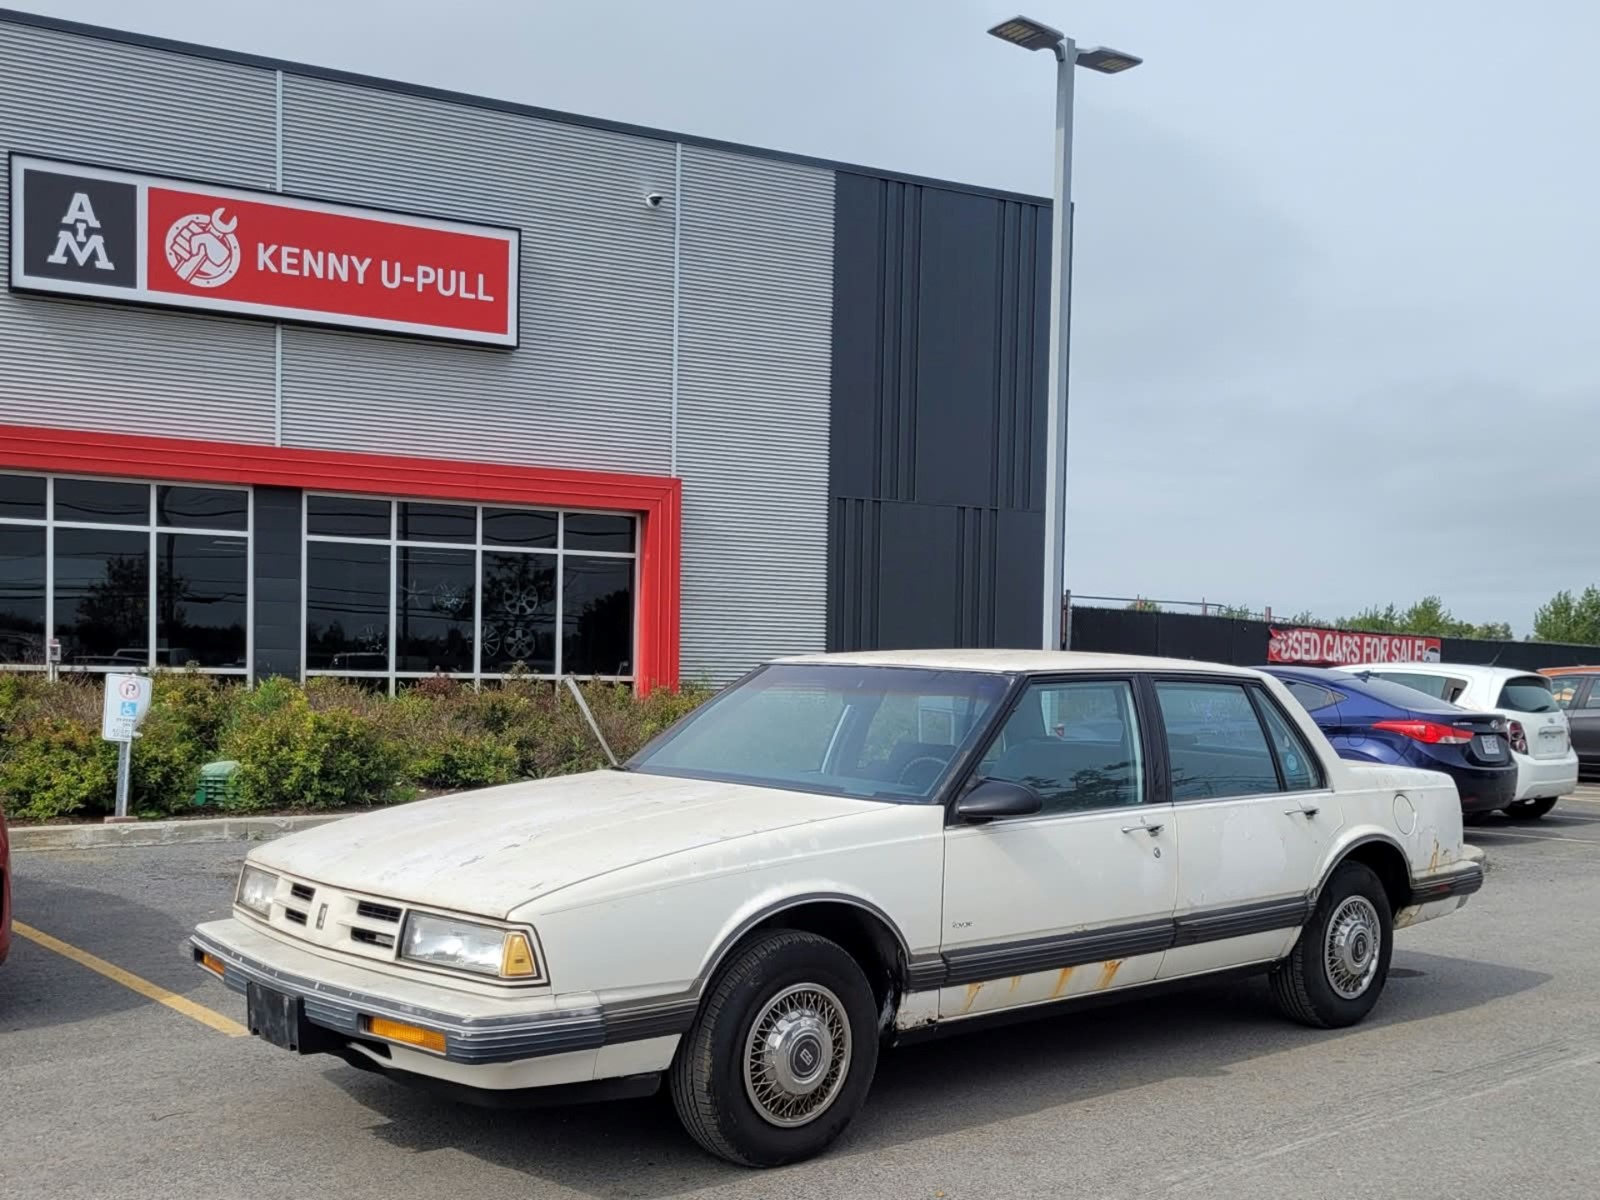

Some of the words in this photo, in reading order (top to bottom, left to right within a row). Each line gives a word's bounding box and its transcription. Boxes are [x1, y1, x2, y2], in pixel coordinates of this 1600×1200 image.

[257, 242, 373, 285] KENNY
[381, 260, 494, 302] U-PULL
[1280, 630, 1320, 661] USED
[1323, 633, 1360, 664] CARS
[1363, 636, 1389, 664] FOR
